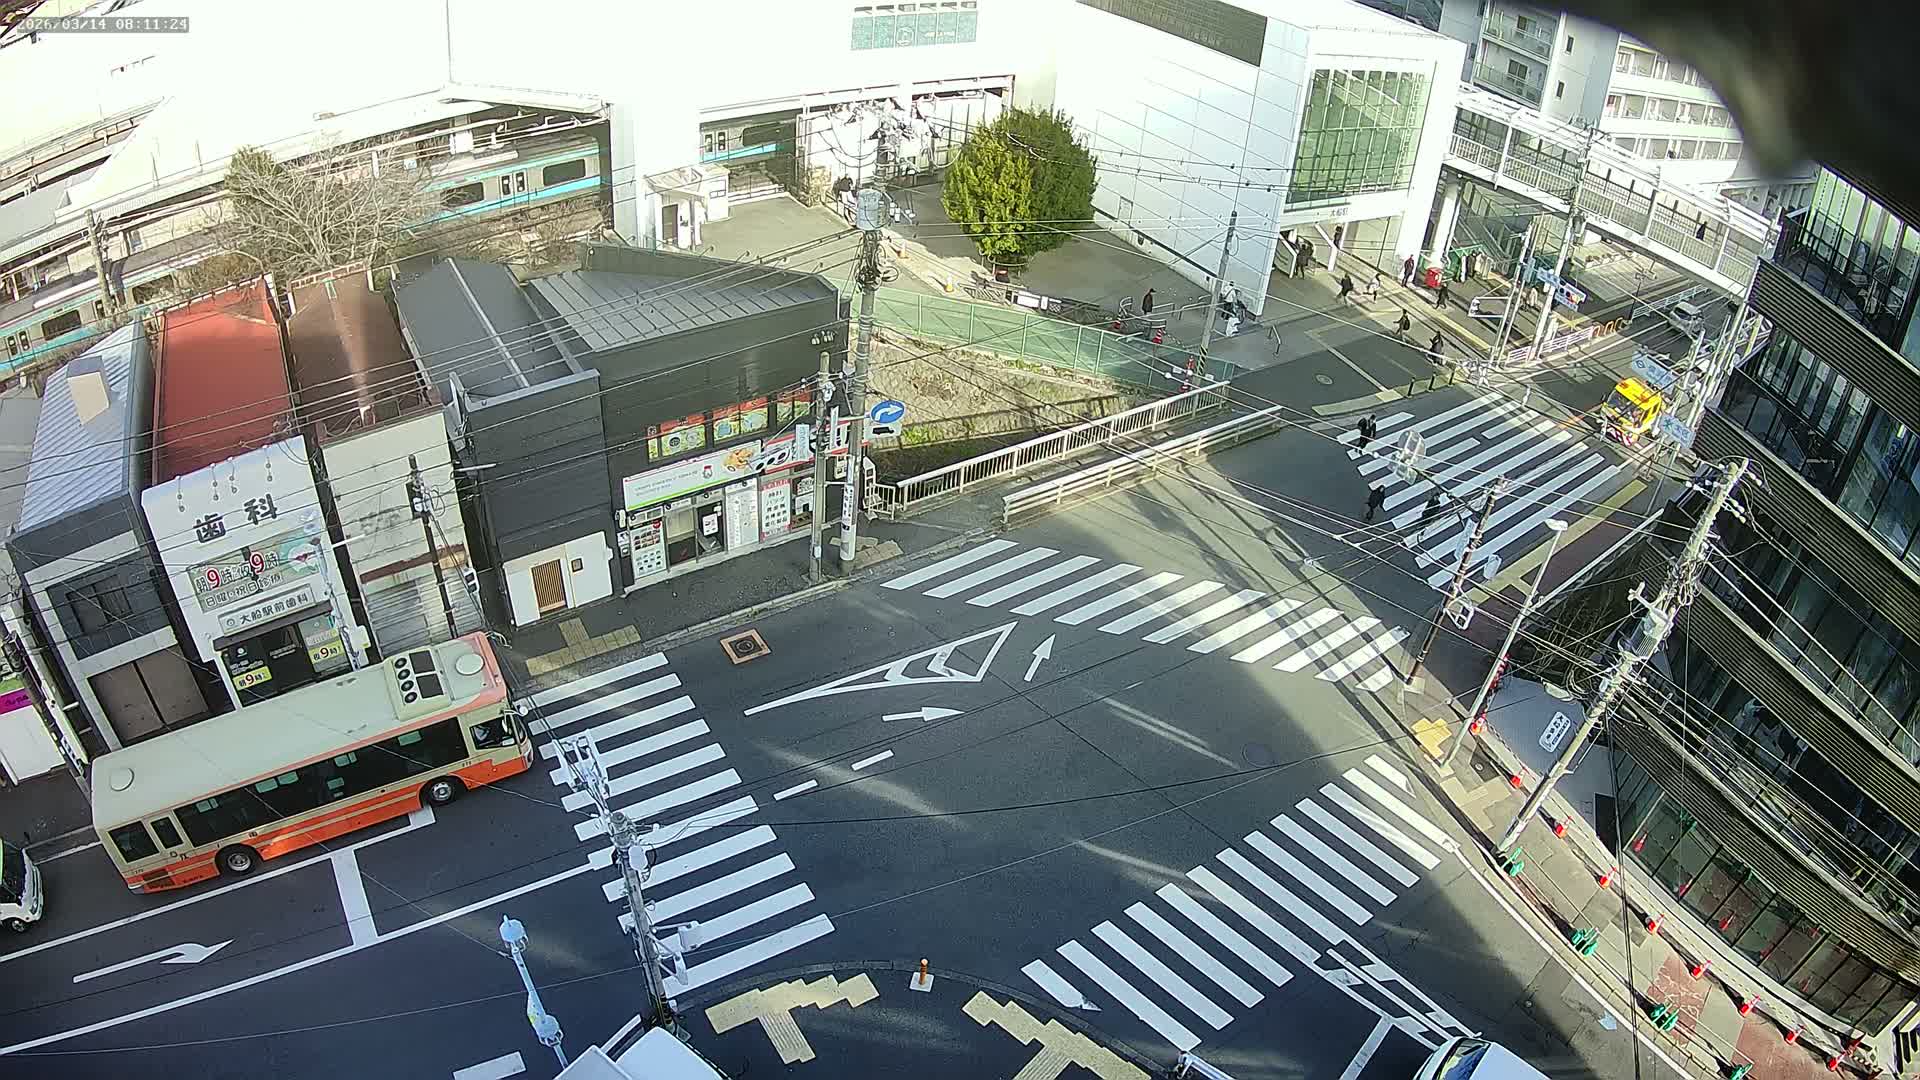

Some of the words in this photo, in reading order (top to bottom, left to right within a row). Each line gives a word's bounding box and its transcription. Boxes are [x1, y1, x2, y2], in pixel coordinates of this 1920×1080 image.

[192, 493, 278, 543] 歯科
[239, 591, 309, 625] 大船駅前歯科
